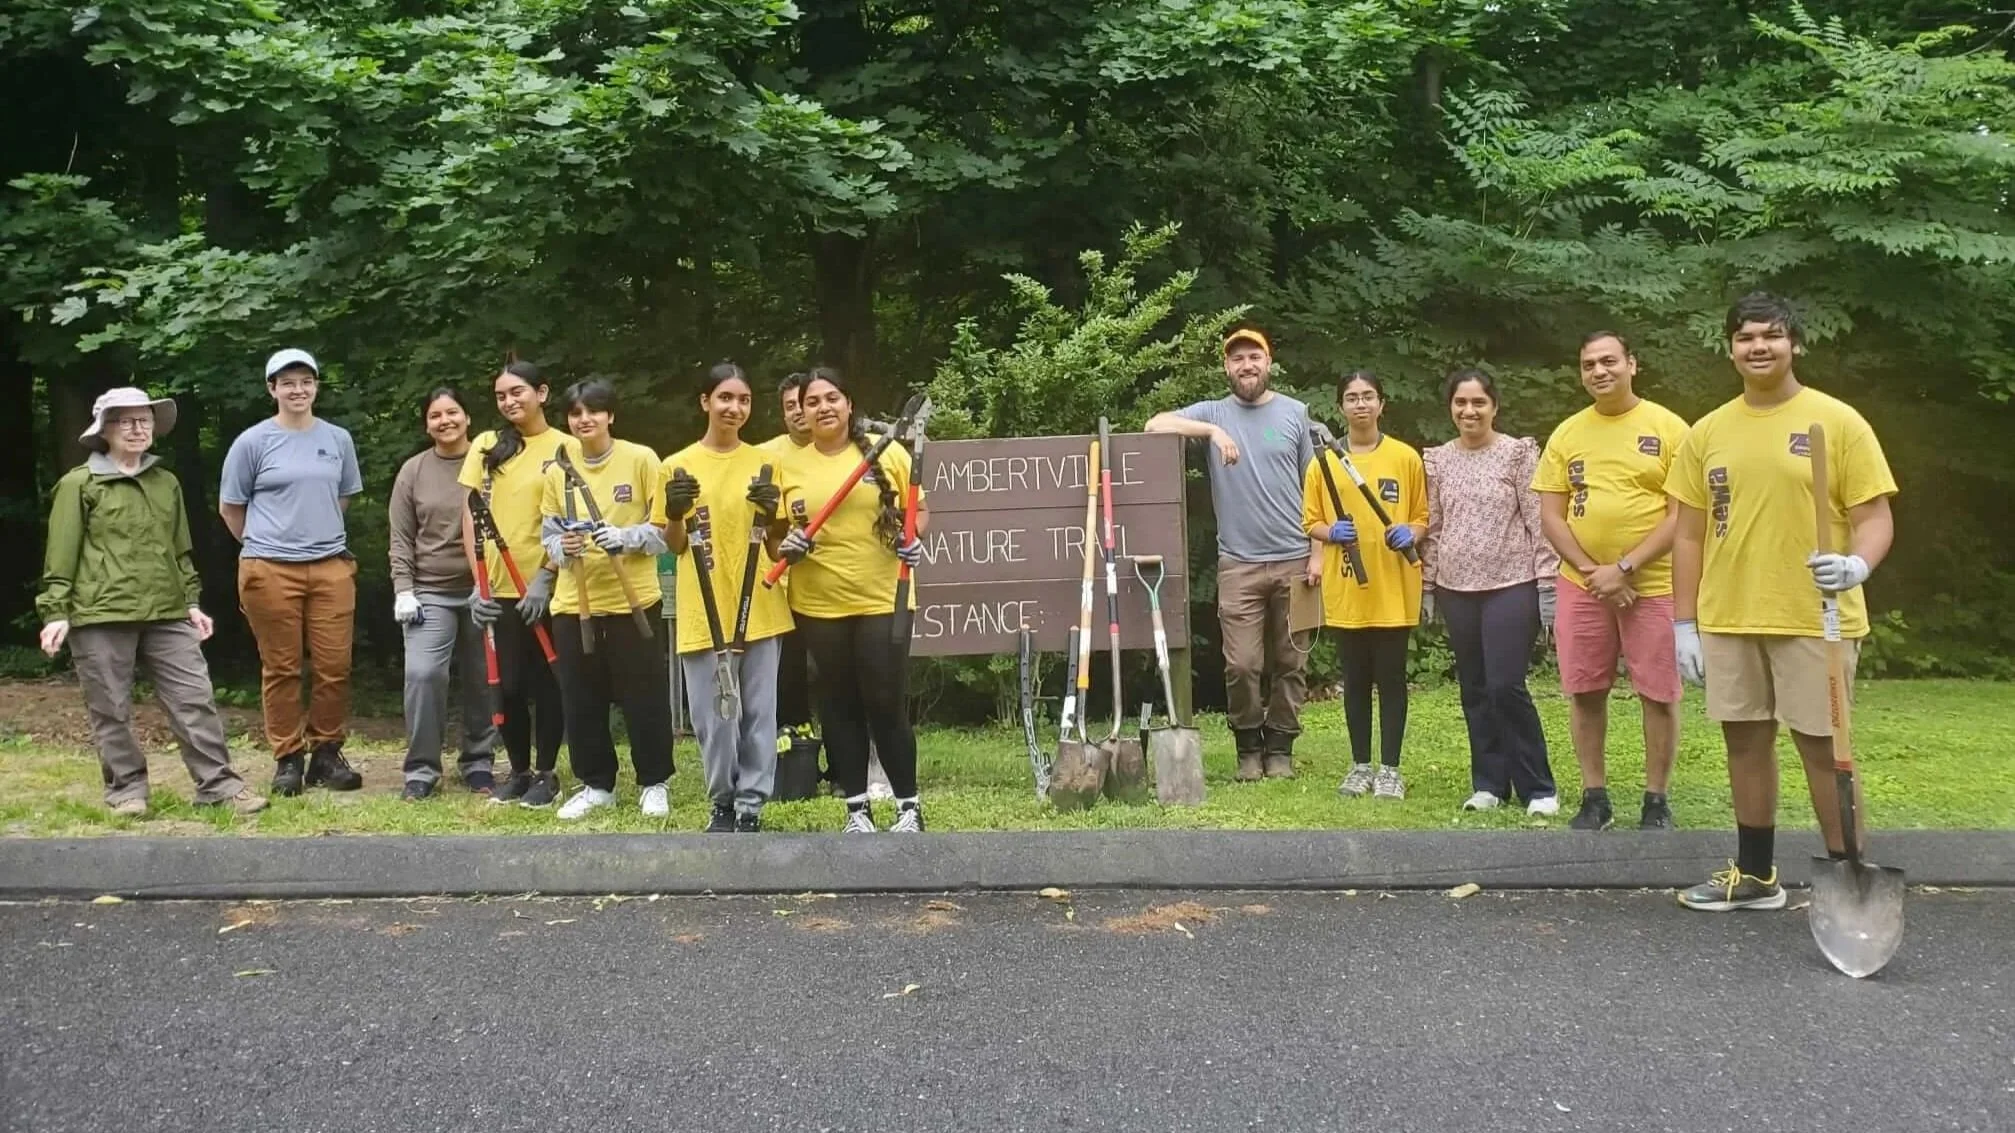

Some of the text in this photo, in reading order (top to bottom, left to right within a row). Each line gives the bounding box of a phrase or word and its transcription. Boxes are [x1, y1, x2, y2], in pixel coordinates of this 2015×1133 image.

[924, 451, 1144, 494] AMBERTVILE
[1708, 467, 1731, 538] sewa
[920, 528, 1028, 565] NATURE
[911, 600, 1045, 638] ISTANCE:
